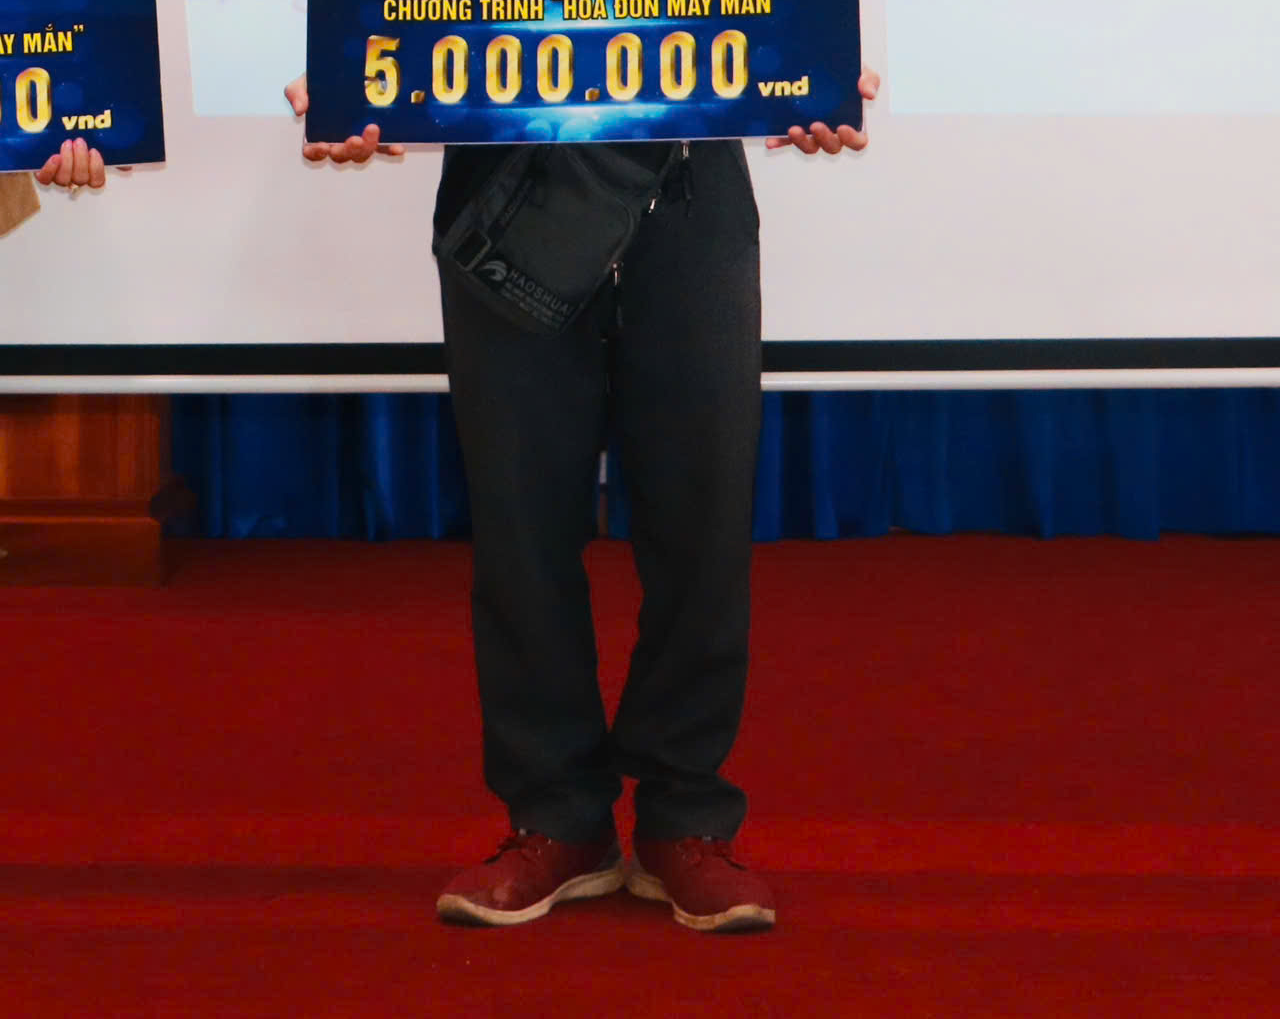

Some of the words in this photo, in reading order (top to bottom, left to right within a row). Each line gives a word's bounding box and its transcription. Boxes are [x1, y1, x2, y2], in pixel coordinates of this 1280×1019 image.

[365, 30, 750, 108] 5.000.000
[758, 76, 810, 97] vnd
[62, 109, 113, 131] vnd
